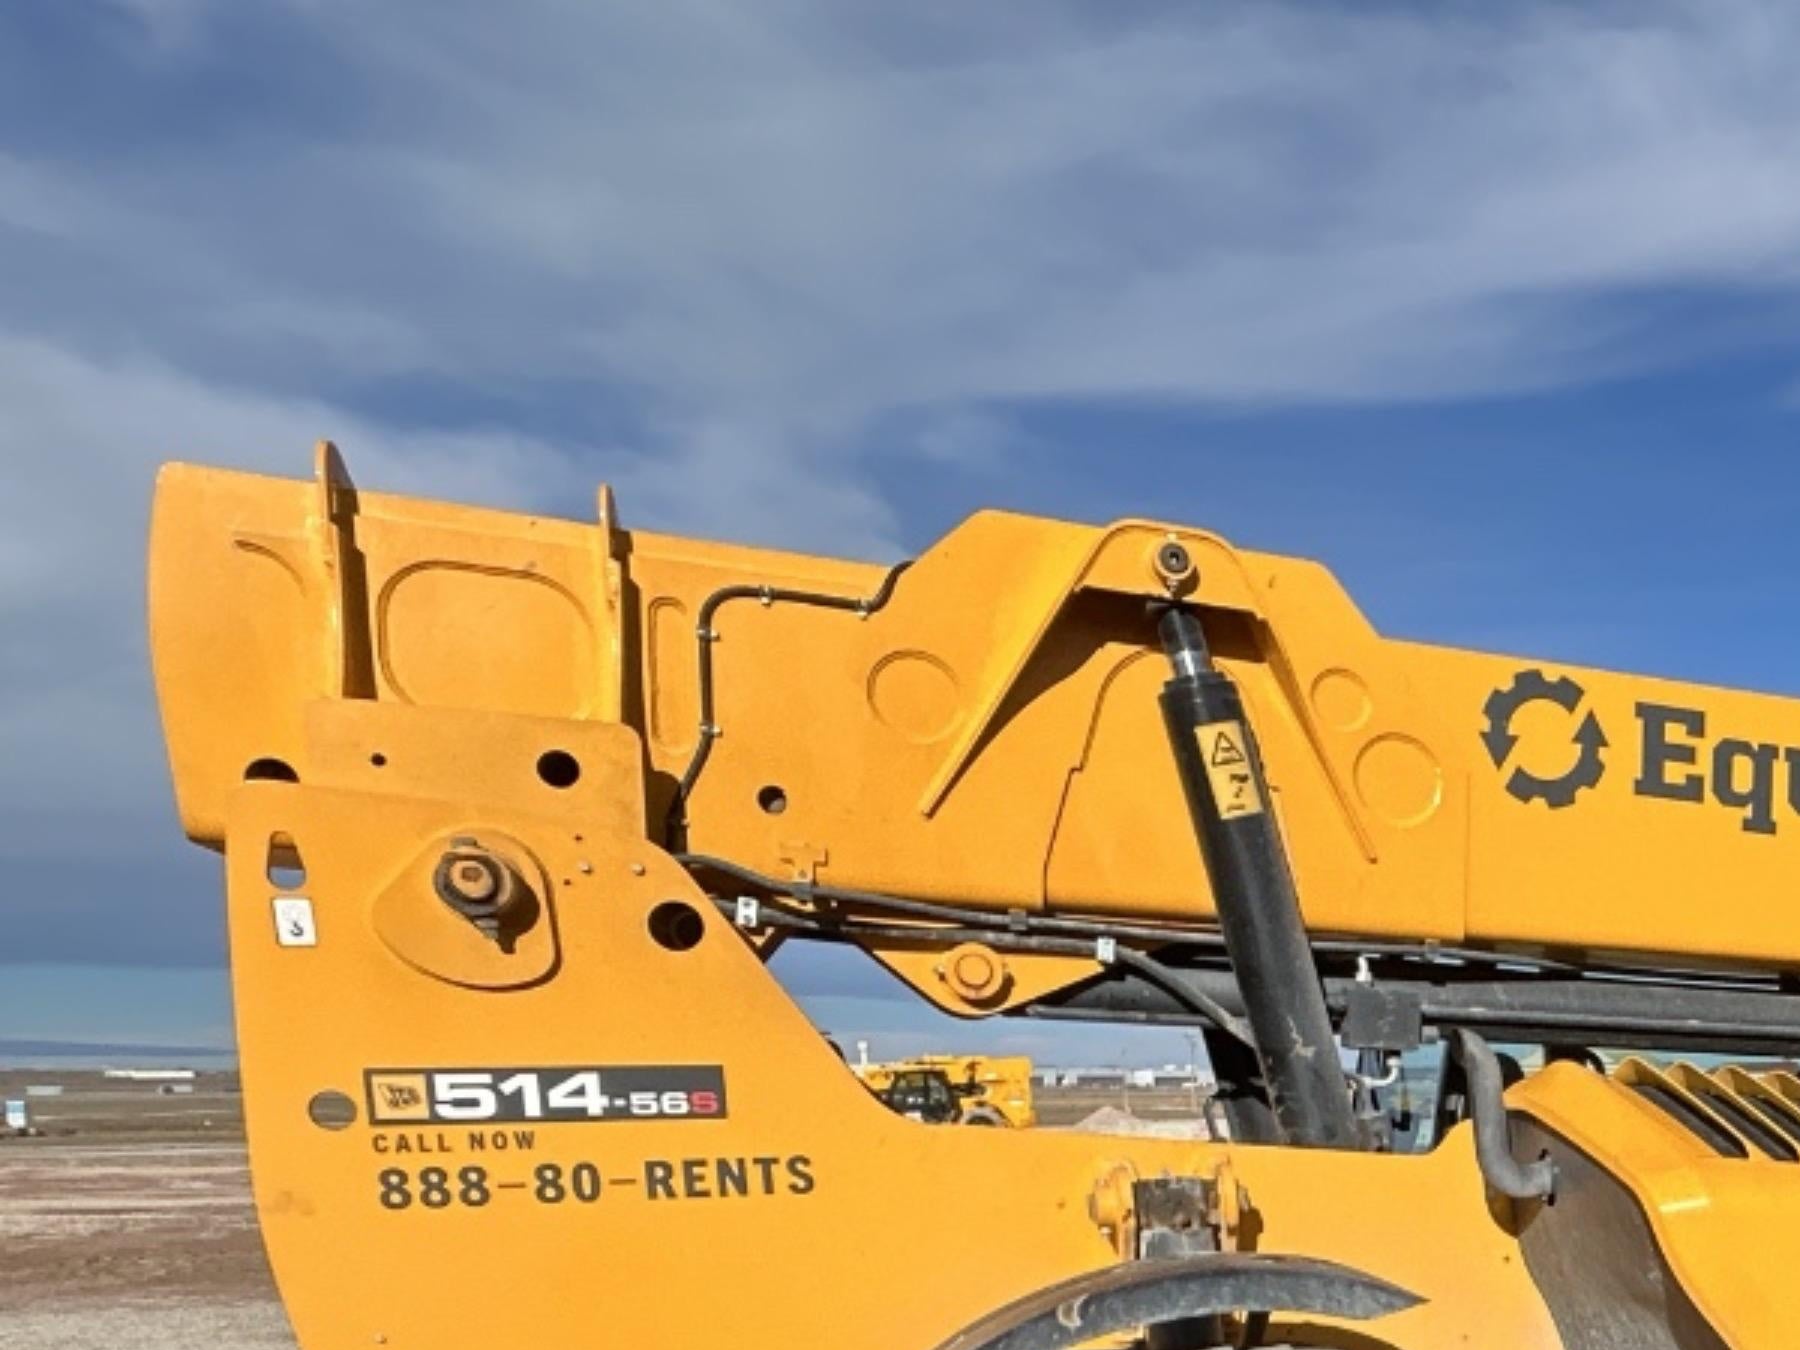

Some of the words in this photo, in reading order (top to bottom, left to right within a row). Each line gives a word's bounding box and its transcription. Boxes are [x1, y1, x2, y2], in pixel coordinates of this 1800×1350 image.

[371, 1131, 454, 1154] CALL
[468, 1129, 536, 1152] NOW
[377, 1155, 817, 1210] 888-80-RENTS
